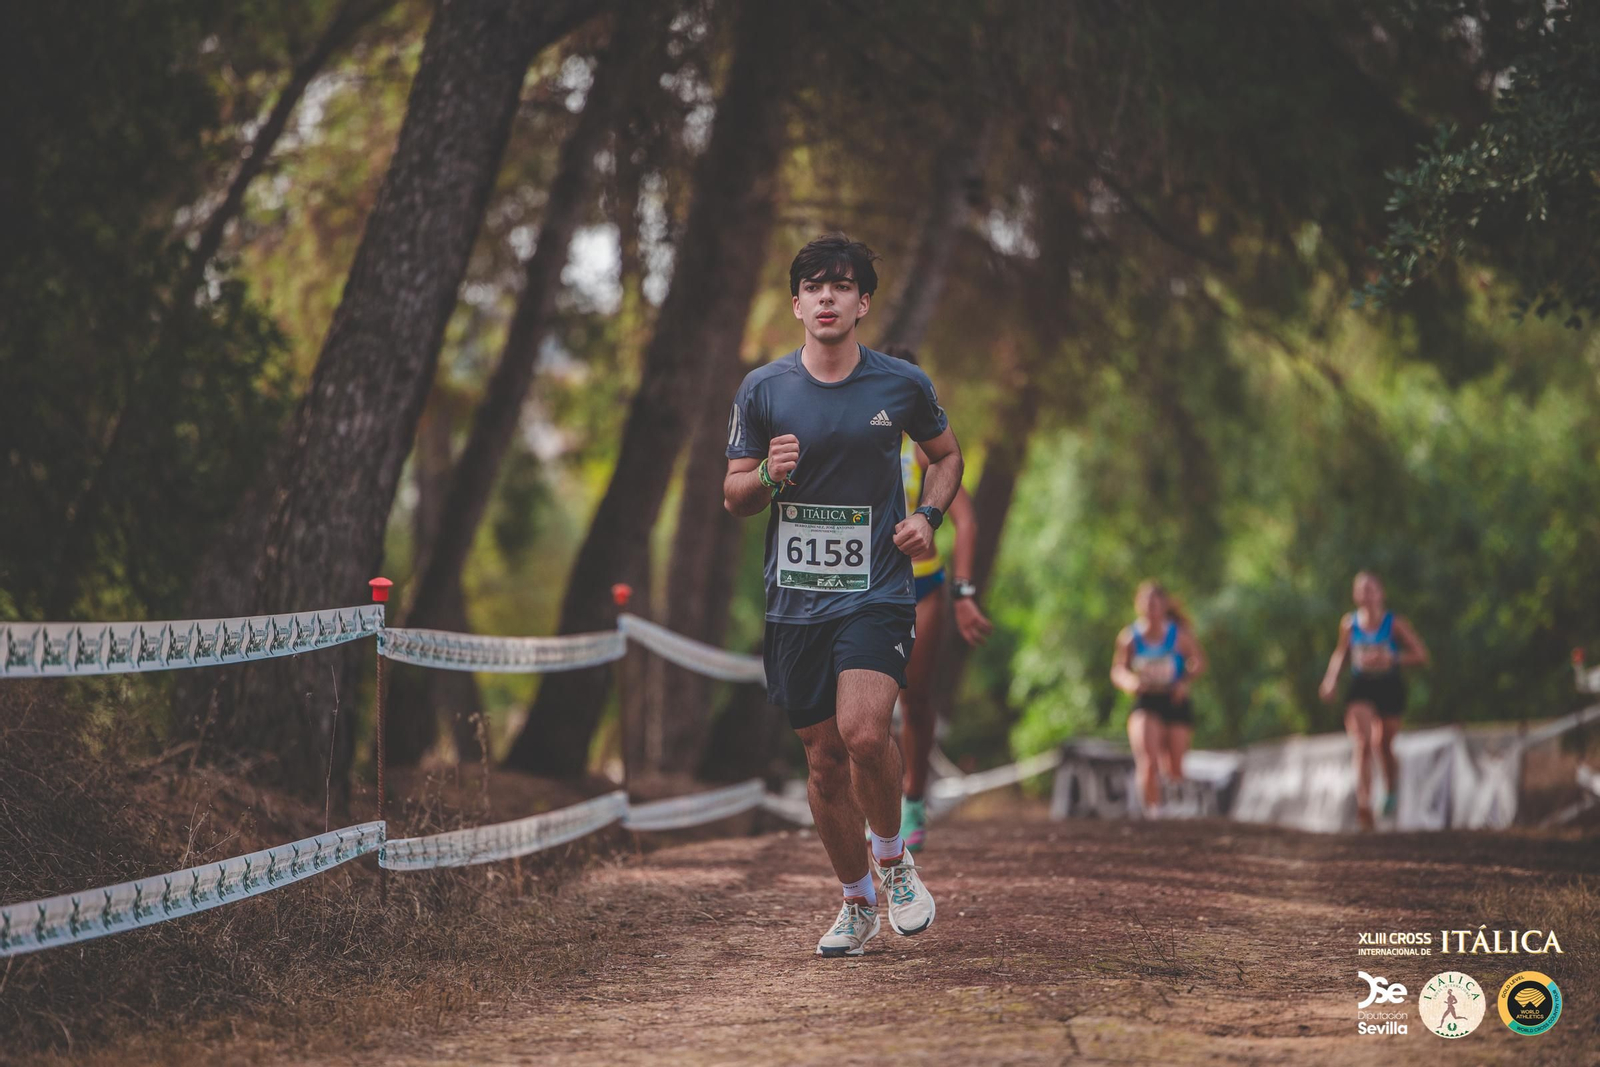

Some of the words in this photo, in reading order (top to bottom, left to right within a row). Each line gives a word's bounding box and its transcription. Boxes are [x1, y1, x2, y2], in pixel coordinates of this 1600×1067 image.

[870, 419, 892, 427] adidas
[802, 508, 847, 520] ITÁLICA
[787, 536, 864, 567] 6158
